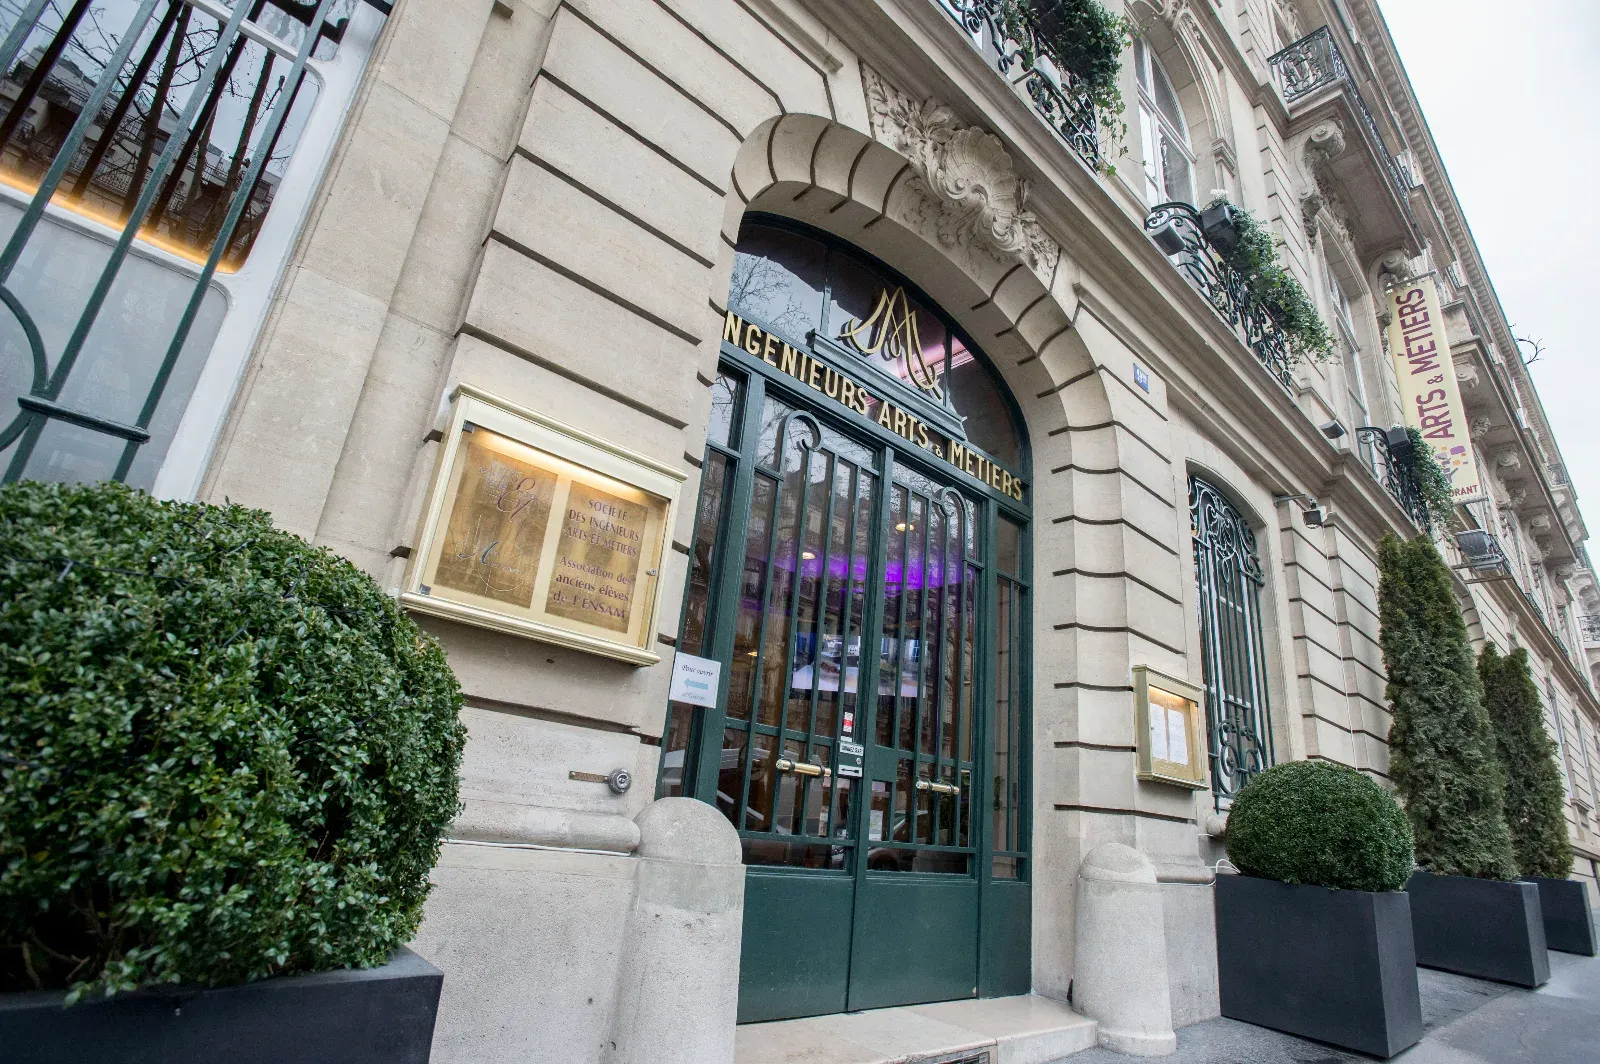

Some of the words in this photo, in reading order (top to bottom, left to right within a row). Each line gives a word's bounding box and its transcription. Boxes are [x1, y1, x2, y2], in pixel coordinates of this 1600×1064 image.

[1395, 288, 1441, 376] MÉTIERS
[1427, 374, 1444, 385] &
[1416, 388, 1455, 439] ARTS
[878, 401, 930, 448] ARTS
[935, 445, 944, 459] &
[950, 439, 1023, 502] METIERS
[569, 509, 586, 523] DES
[565, 526, 587, 541] ARTS
[590, 533, 601, 545] ET
[560, 556, 614, 580] Association
[616, 573, 632, 586] des
[553, 590, 568, 604] de
[555, 574, 596, 593] anciens
[598, 584, 629, 602] élèves
